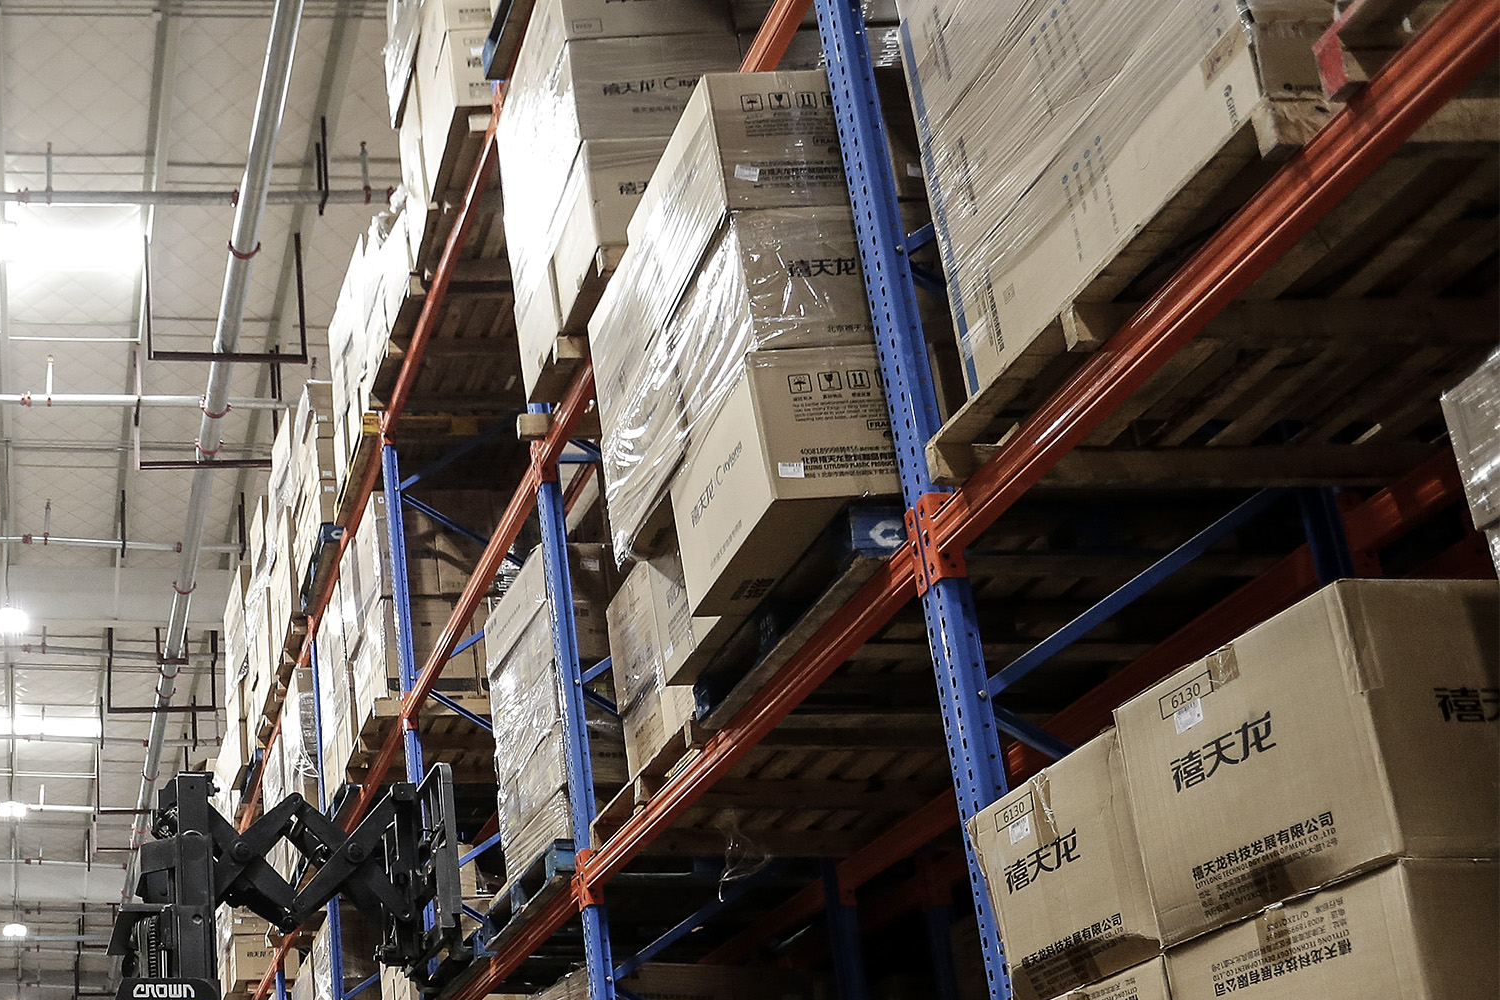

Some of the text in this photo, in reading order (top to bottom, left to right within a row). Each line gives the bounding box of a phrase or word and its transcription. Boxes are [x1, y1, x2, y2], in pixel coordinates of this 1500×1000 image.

[787, 257, 856, 278] 禧天龙
[1170, 682, 1201, 709] 6130
[1169, 711, 1278, 794] 禧天龙
[1003, 801, 1025, 823] 6130
[1004, 828, 1081, 895] 禧天龙
[1189, 810, 1335, 881] 禧天龙科技发展有限公司
[1020, 912, 1124, 970] 禧天龙科技发展有限公司
[1212, 937, 1353, 997] 禧天龙科技发展有限公司
[132, 983, 196, 998] CROWN
